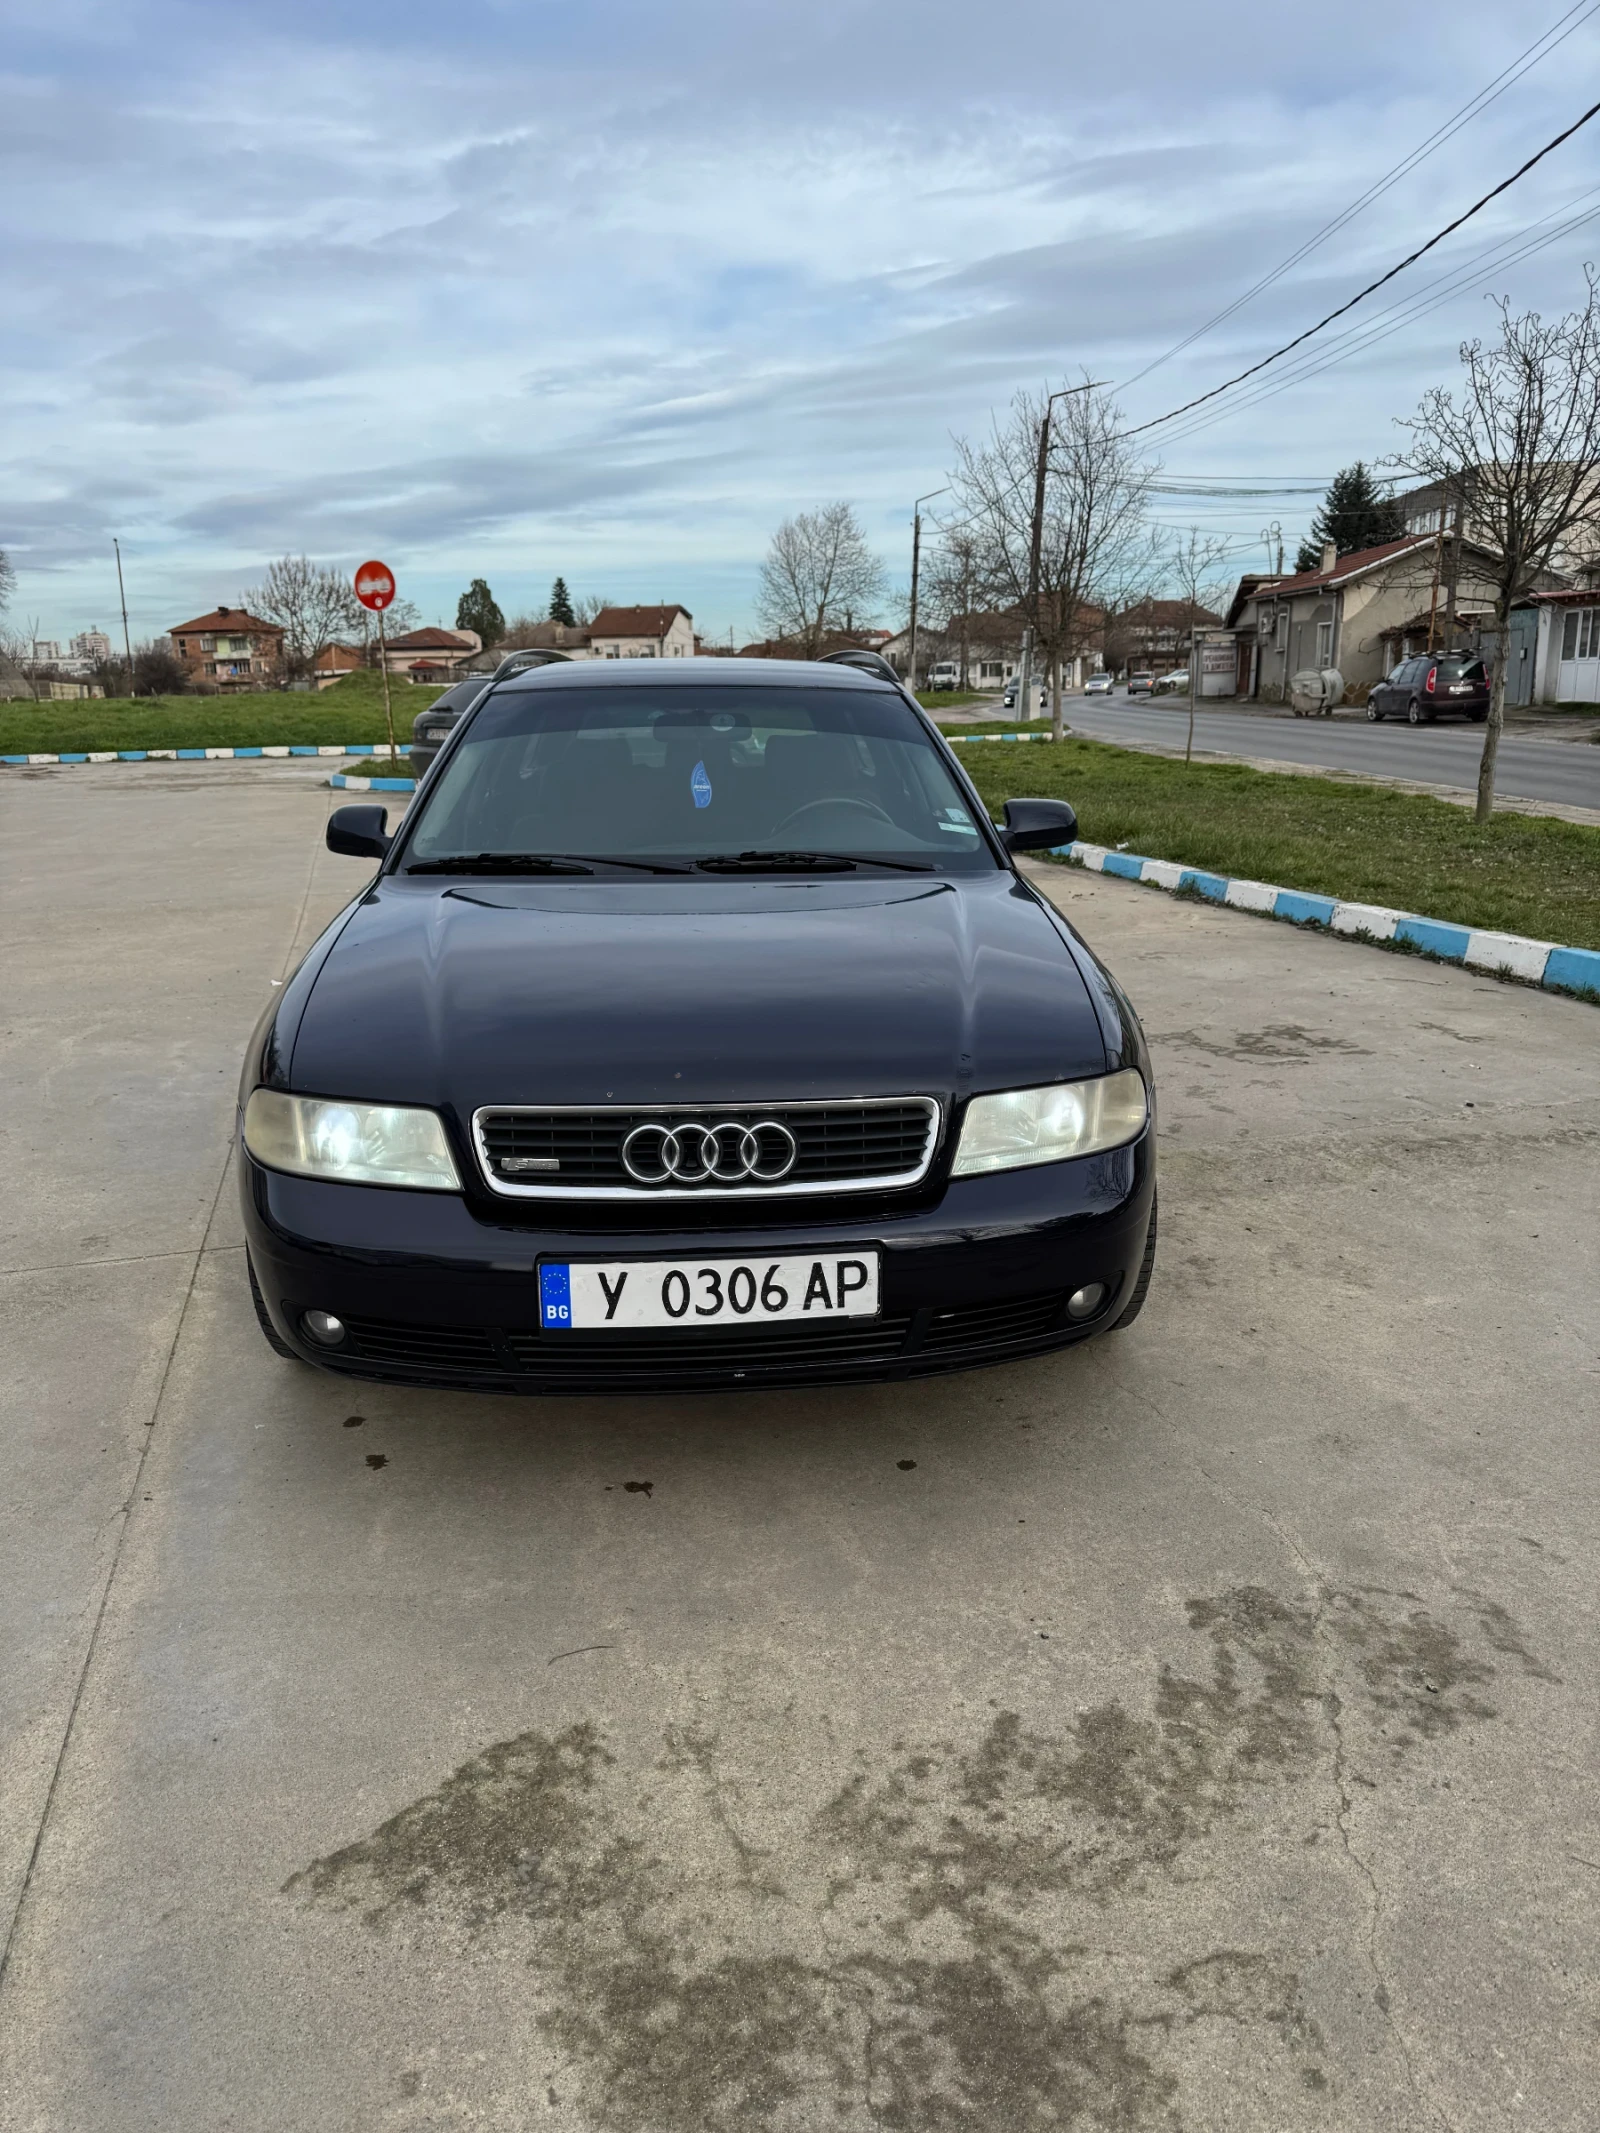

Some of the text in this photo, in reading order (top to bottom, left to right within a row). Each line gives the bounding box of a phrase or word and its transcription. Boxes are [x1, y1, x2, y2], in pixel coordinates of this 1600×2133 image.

[661, 1264, 789, 1318] 0306
[802, 1260, 868, 1311] AP
[547, 1305, 569, 1320] BG
